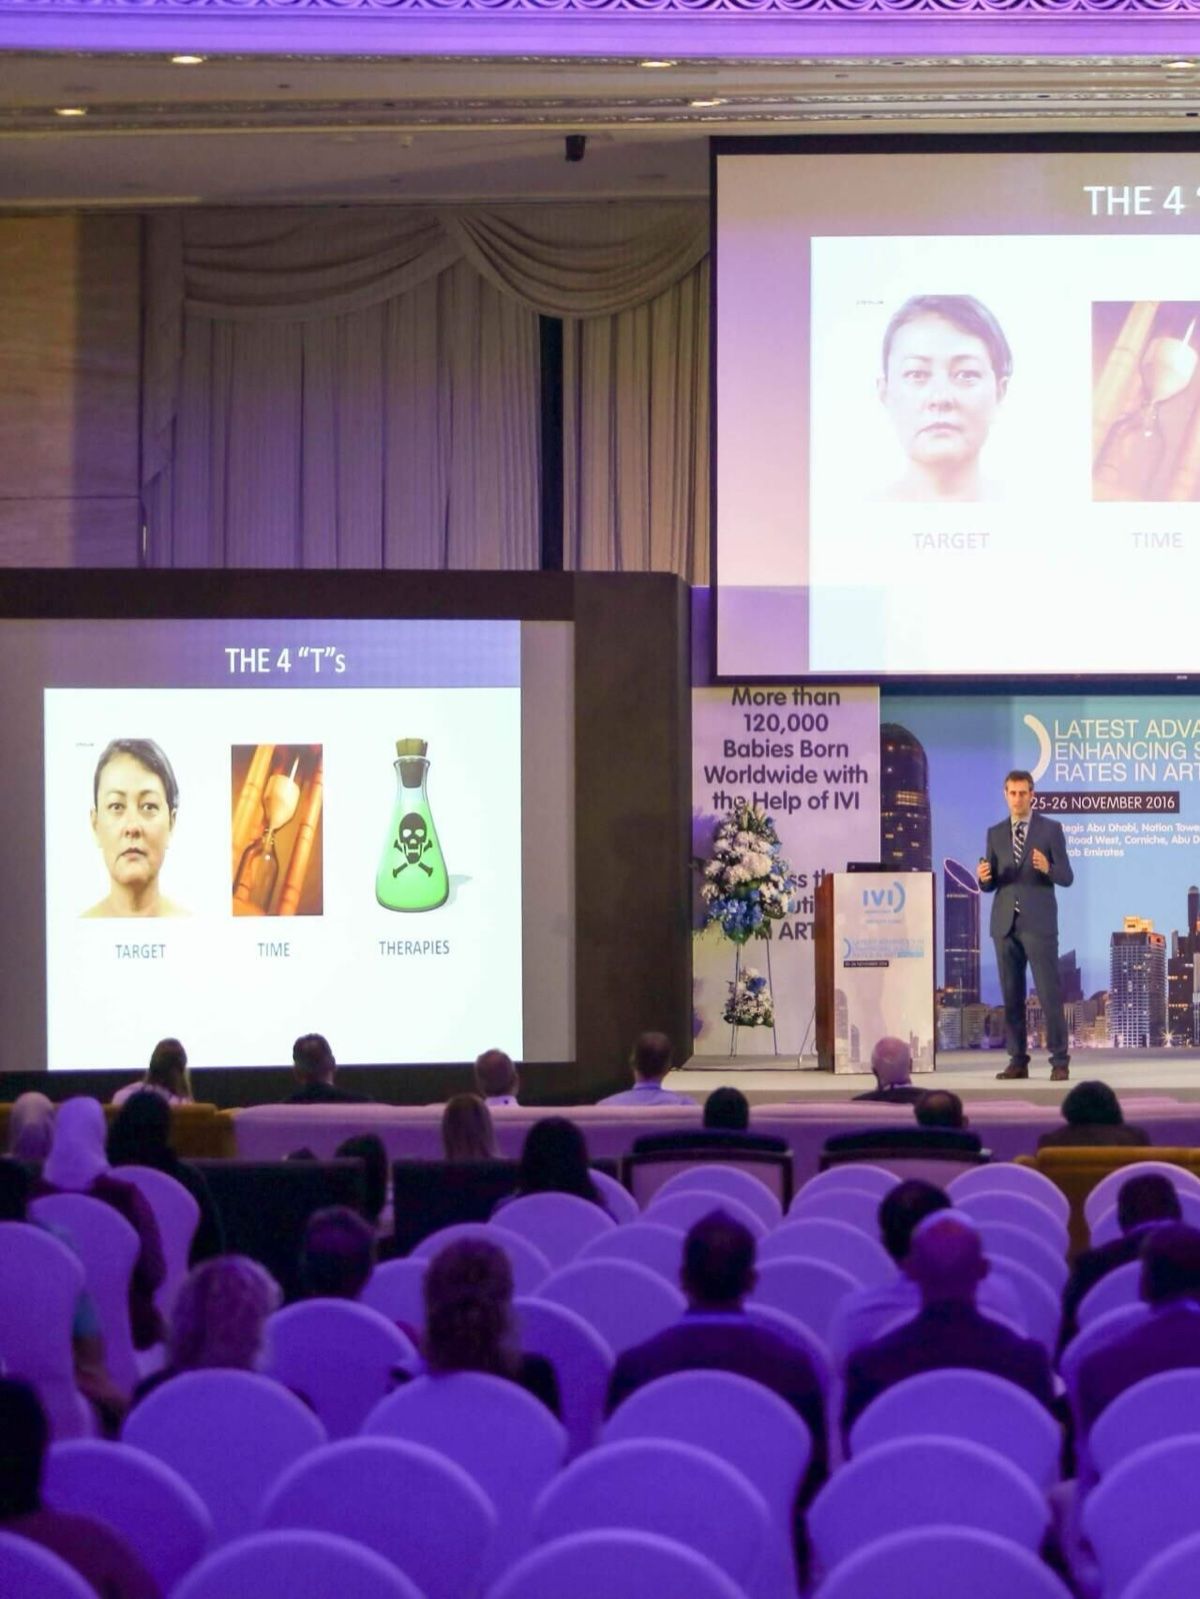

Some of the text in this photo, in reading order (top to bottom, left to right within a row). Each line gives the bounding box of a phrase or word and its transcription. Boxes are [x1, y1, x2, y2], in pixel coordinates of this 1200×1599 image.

[1083, 186, 1152, 217] THE
[1163, 186, 1186, 217] 4
[912, 532, 991, 550] TARGET
[1131, 532, 1184, 550] TIME
[225, 648, 270, 673] THE
[276, 648, 291, 673] 4
[732, 686, 840, 706] More than
[744, 713, 829, 735] 120,000
[1055, 719, 1139, 739] LATEST
[723, 738, 849, 758] Babies Born
[1055, 742, 1186, 761] ENHANCING
[704, 764, 868, 784] Worldwide with
[1055, 763, 1127, 782] RATES
[1135, 763, 1154, 781] IN
[712, 790, 859, 815] the Help of IVI
[1031, 796, 1175, 810] 25-26 NOVEMBER 2016
[1086, 823, 1105, 833] Abu
[1108, 823, 1139, 834] Dhabi,
[1142, 823, 1173, 833] Nation
[1069, 836, 1092, 845] Road
[1095, 836, 1121, 847] West,
[1125, 835, 1168, 847] Corniche,
[1171, 835, 1190, 845] Abu
[1066, 848, 1124, 858] rab Emirates
[115, 944, 166, 959] TARGET
[258, 942, 290, 957] TIME
[379, 940, 450, 956] THERAPIES
